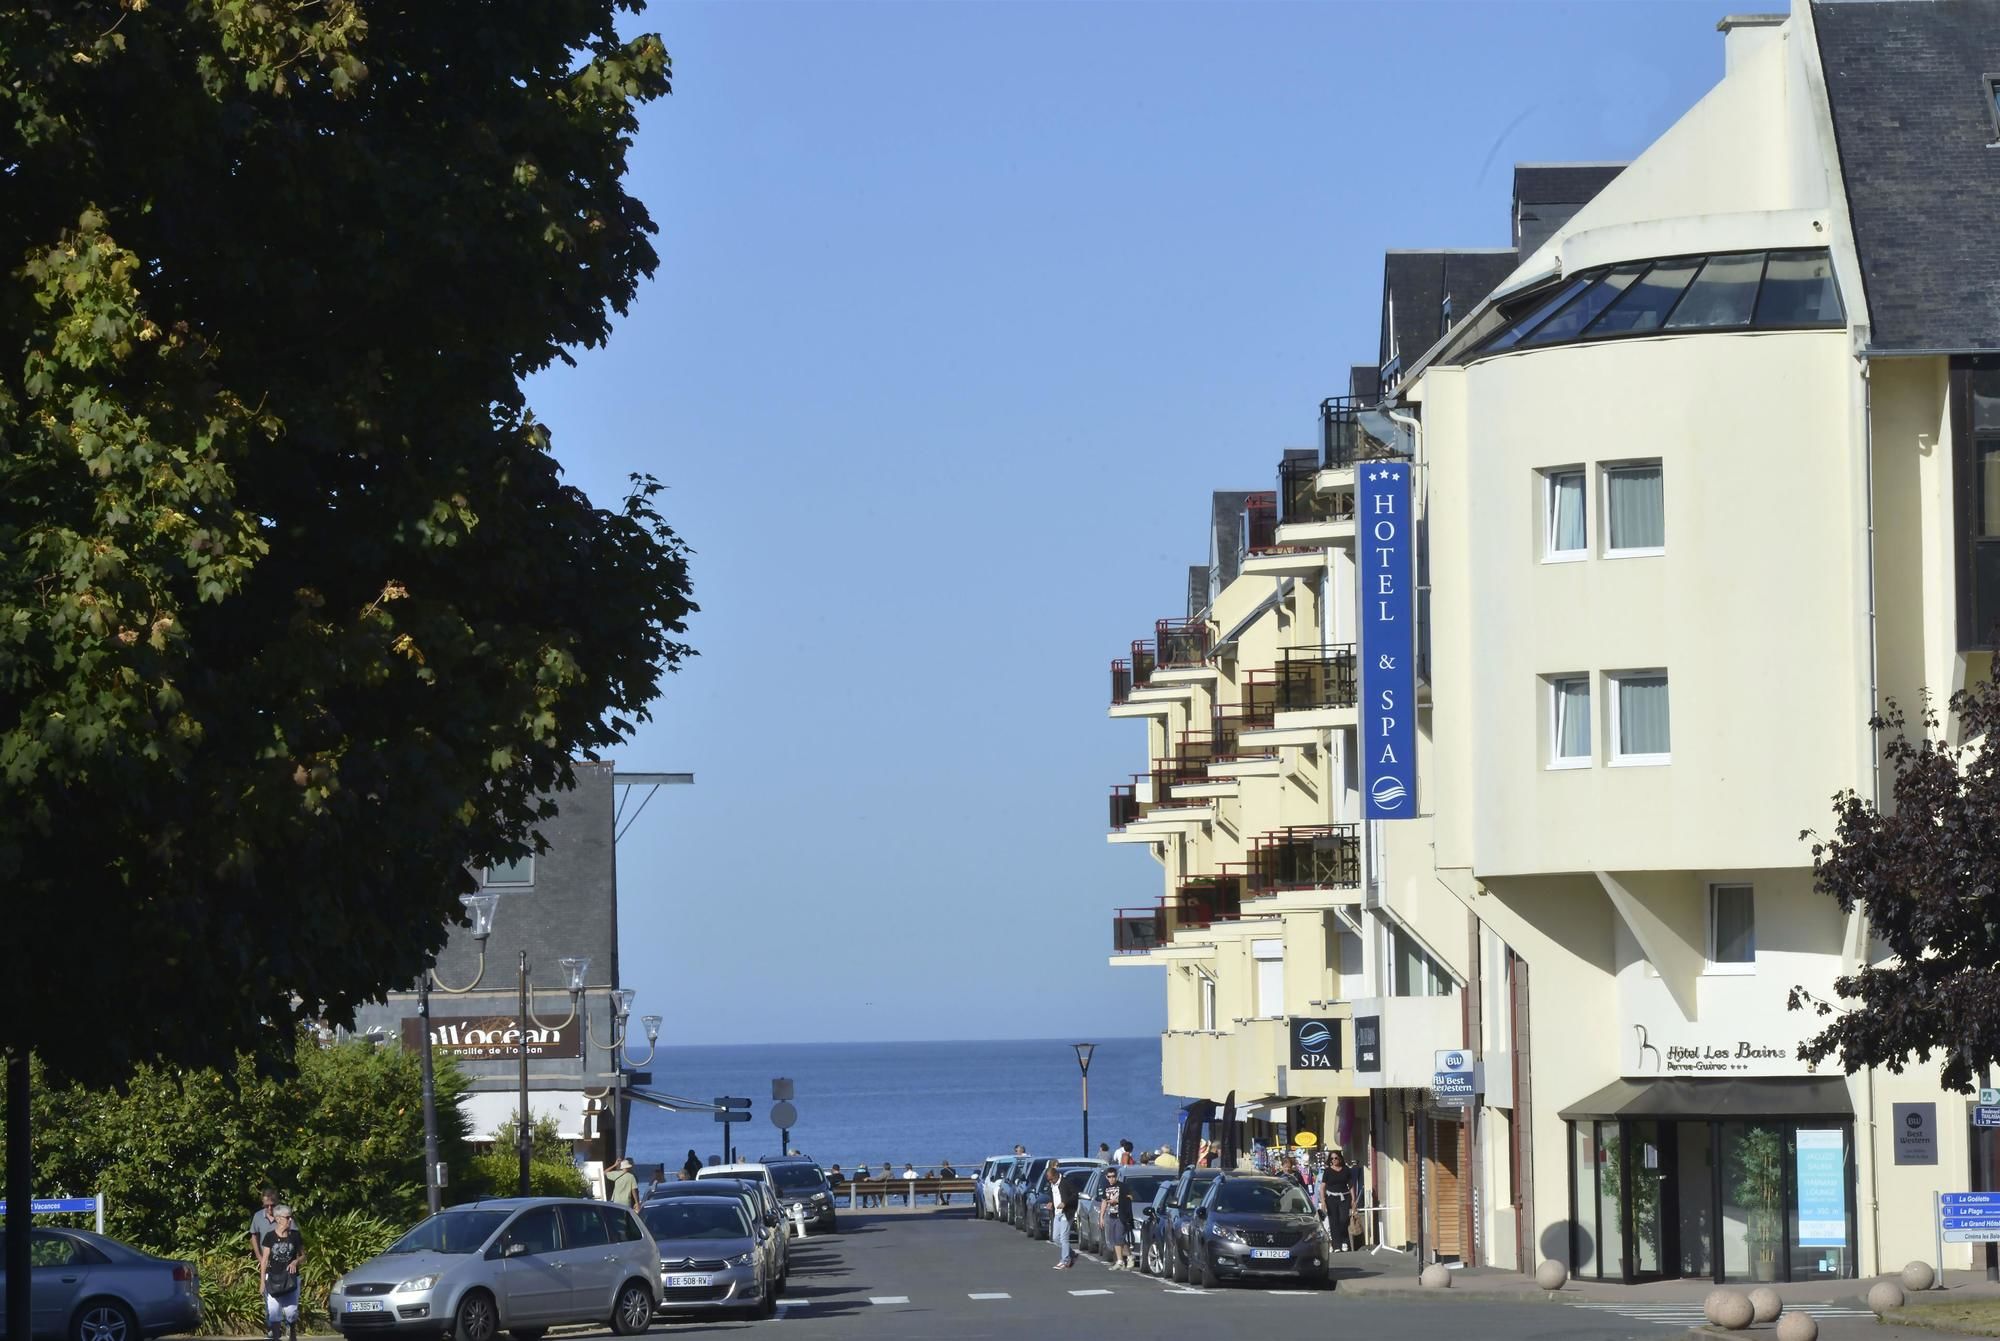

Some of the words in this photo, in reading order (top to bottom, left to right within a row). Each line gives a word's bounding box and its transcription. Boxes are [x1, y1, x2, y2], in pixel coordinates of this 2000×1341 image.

[1373, 494, 1395, 621] HOTEL
[1379, 654, 1396, 670] &
[1379, 689, 1398, 764] SPA
[489, 1047, 501, 1055] de
[1667, 1045, 1700, 1063] Hôtel
[1704, 1045, 1729, 1060] Les
[1734, 1041, 1786, 1060] Bains
[1300, 1054, 1331, 1067] SPA
[1447, 1056, 1462, 1066] BW
[1446, 1077, 1465, 1085] Best
[34, 1202, 60, 1210] Vacances
[1960, 1207, 1967, 1215] La
[1967, 1207, 1984, 1216] Plage
